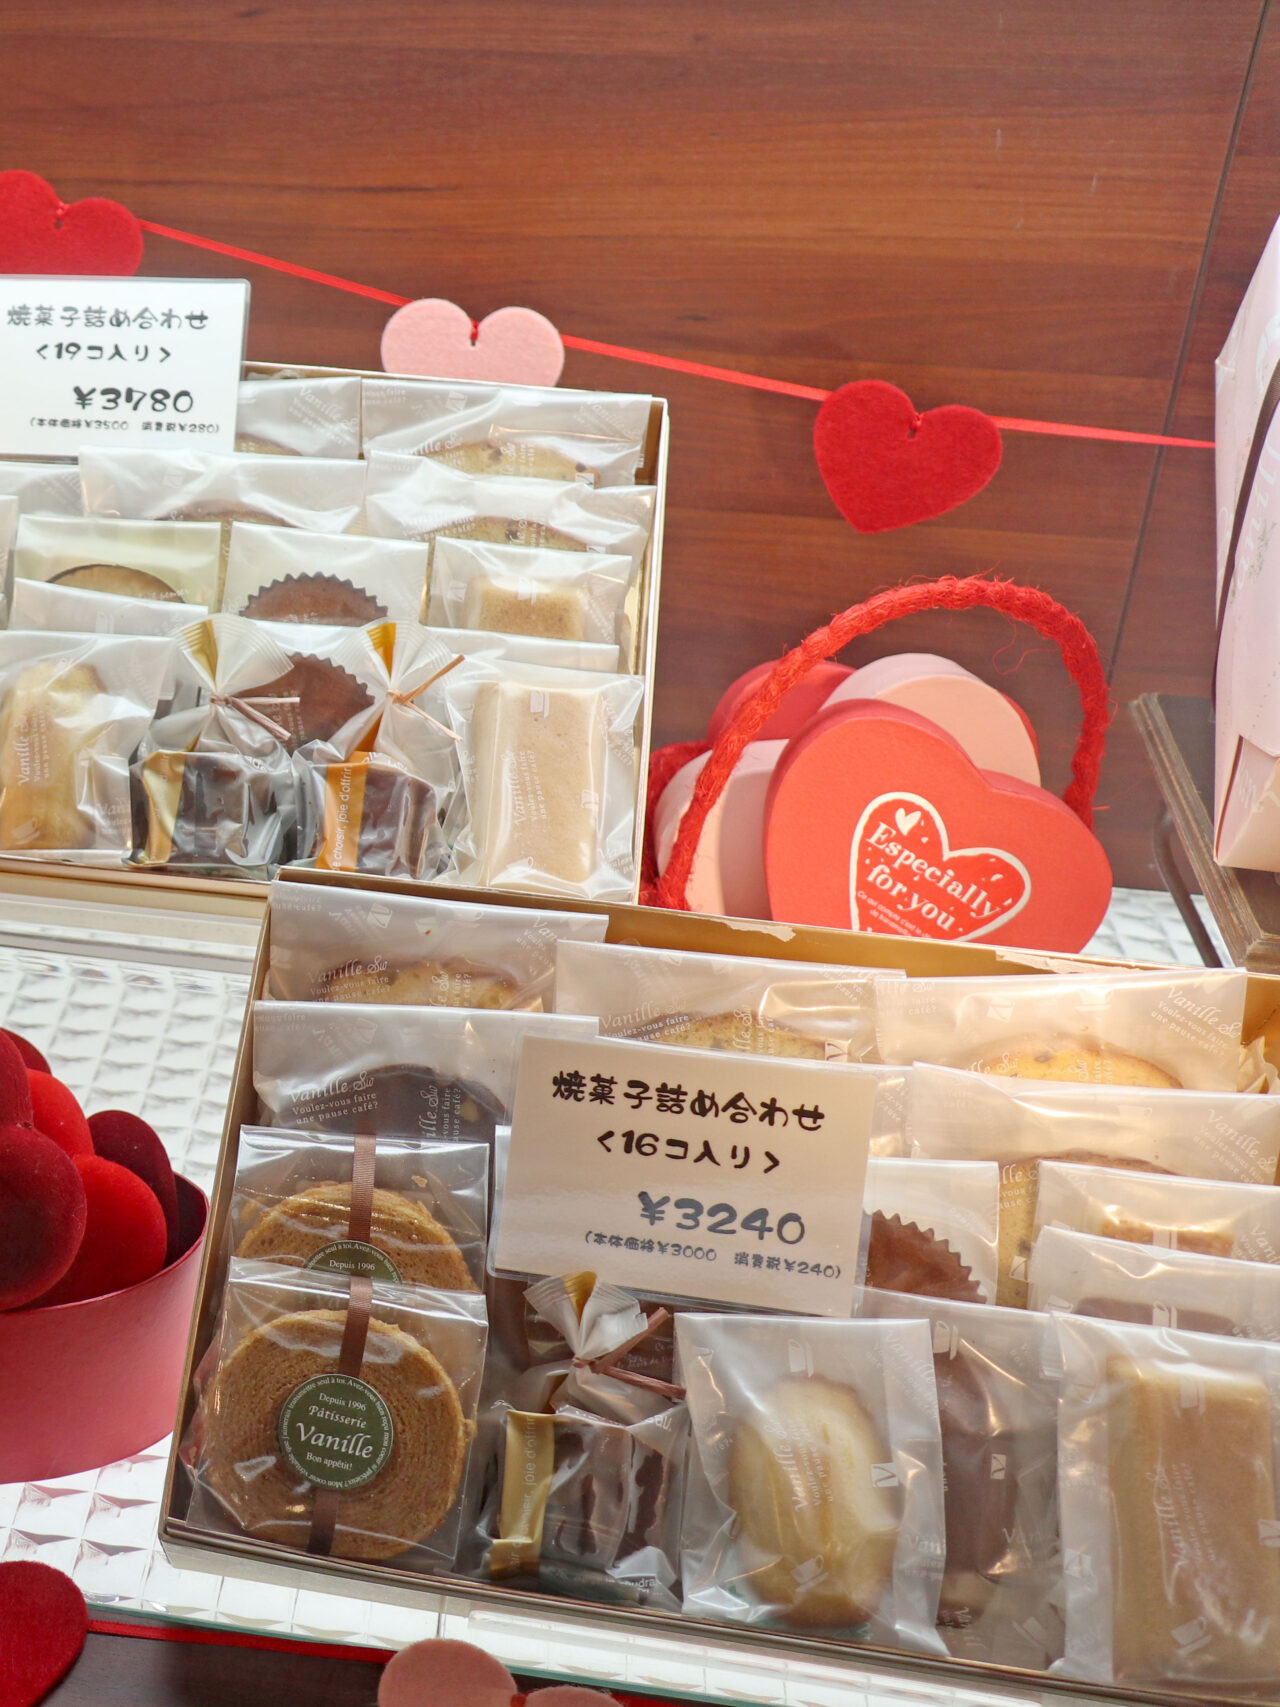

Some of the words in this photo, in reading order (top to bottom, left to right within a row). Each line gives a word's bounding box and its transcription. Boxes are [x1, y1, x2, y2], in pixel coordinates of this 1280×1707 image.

[7, 303, 209, 331] 焼菓子詰め合わせ
[73, 385, 194, 414] ¥3780
[13, 735, 31, 787] Vanille
[866, 821, 1002, 918] Especially
[866, 863, 909, 898] for
[896, 891, 956, 931] you
[1168, 984, 1223, 1026] Vanille
[289, 1074, 352, 1104] Vanille
[551, 1069, 826, 1132] 焼菓子詰め合わせ
[292, 1097, 352, 1116] Voulez-vous
[354, 1092, 377, 1104] faire
[295, 1115, 316, 1125] une
[318, 1107, 350, 1122] pause
[351, 1101, 379, 1114] café?
[420, 1114, 437, 1139] ille
[637, 1190, 806, 1245] ¥3240
[329, 1259, 355, 1270] Depuis
[357, 1262, 376, 1271] 1996
[319, 1392, 346, 1406] Depuis
[348, 1399, 367, 1412] 1996
[308, 1405, 367, 1429] Pâtisserie
[295, 1422, 374, 1459] Vanille
[306, 1452, 322, 1464] Bon
